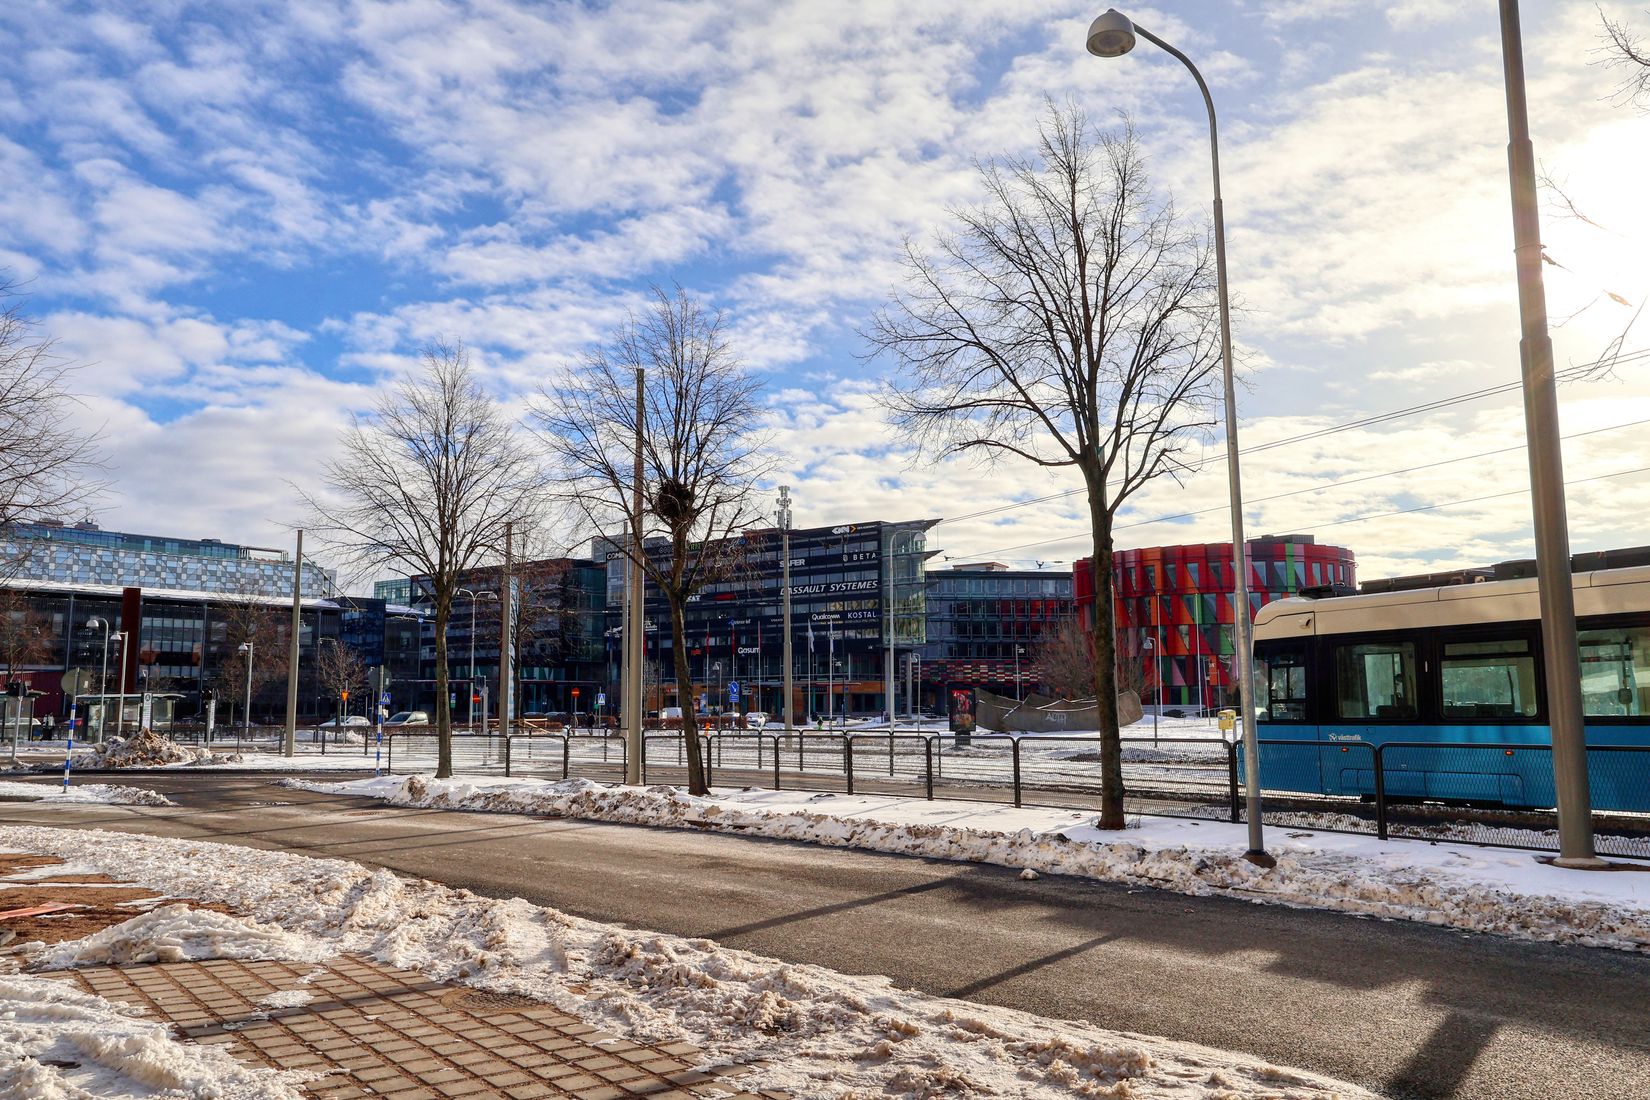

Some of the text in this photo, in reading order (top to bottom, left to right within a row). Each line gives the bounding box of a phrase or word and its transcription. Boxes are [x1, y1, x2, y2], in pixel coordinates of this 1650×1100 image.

[853, 552, 876, 561] BETA
[829, 580, 878, 592] SYSTEMES
[811, 613, 841, 621] Qualcomm
[847, 611, 876, 619] KOSTAL
[737, 646, 761, 655] Gasum
